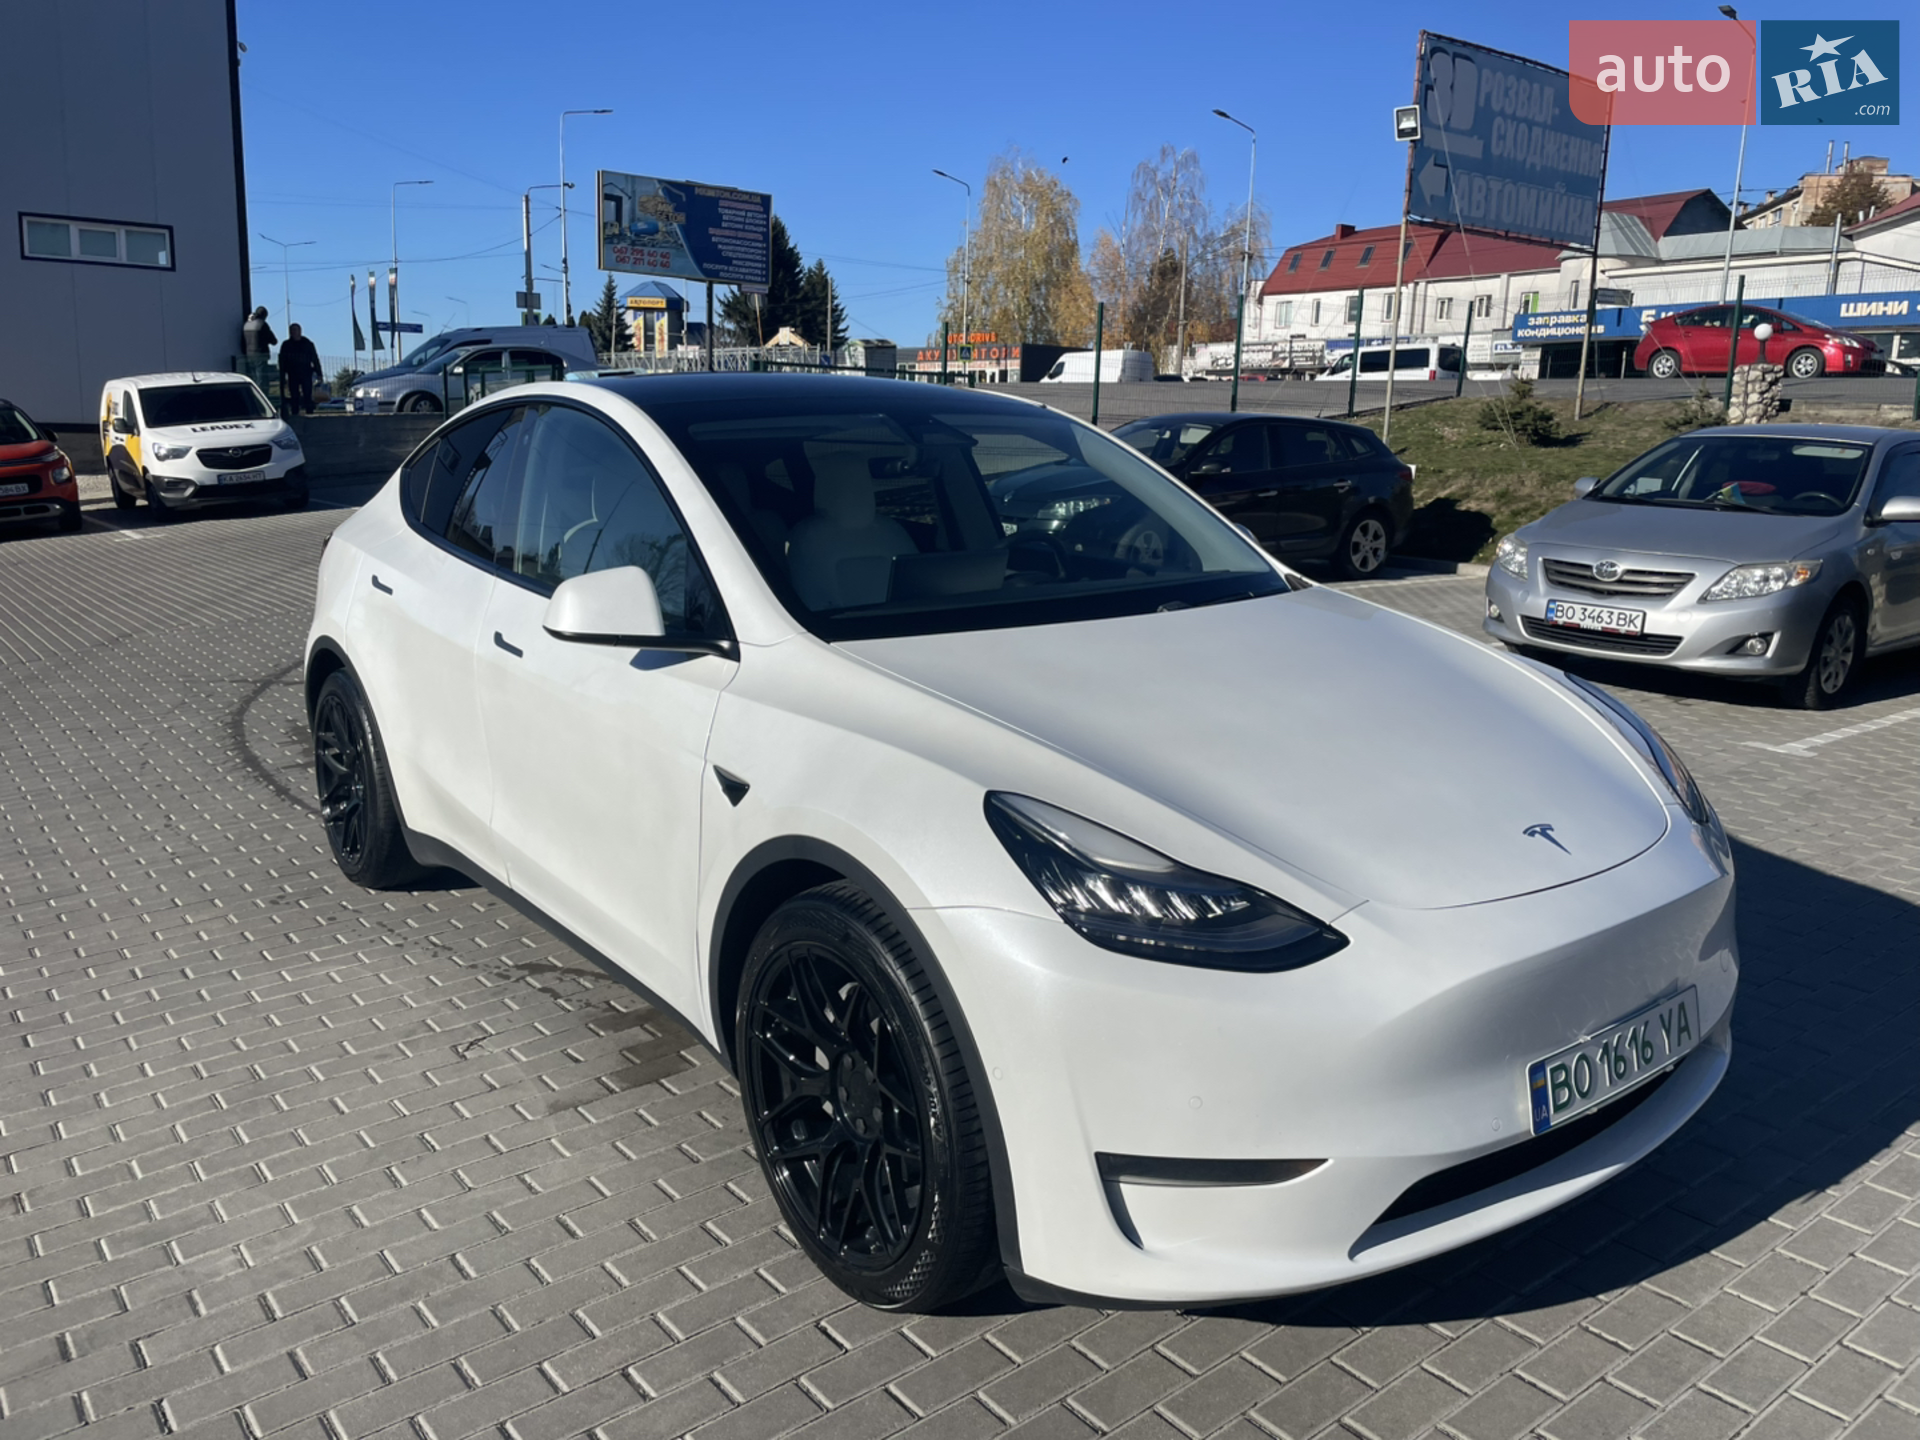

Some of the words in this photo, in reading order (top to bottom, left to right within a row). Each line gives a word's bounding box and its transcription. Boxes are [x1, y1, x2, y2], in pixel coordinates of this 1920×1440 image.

[1478, 68, 1560, 126] РОЗВАЛ-
[1491, 115, 1602, 178] СХОДЖЕННЯ
[1453, 169, 1595, 239] АВТОМИЙКА
[1527, 314, 1588, 328] заправка
[1840, 301, 1909, 318] ШИНИ
[1517, 324, 1605, 339] кондиціонеів
[190, 422, 255, 433] LEADEX
[1555, 604, 1576, 620] BO
[1579, 607, 1614, 625] 3463
[1616, 612, 1641, 629] BK
[1546, 1051, 1593, 1115] BO
[1596, 1020, 1655, 1088] 1616
[1659, 1001, 1692, 1055] YA
